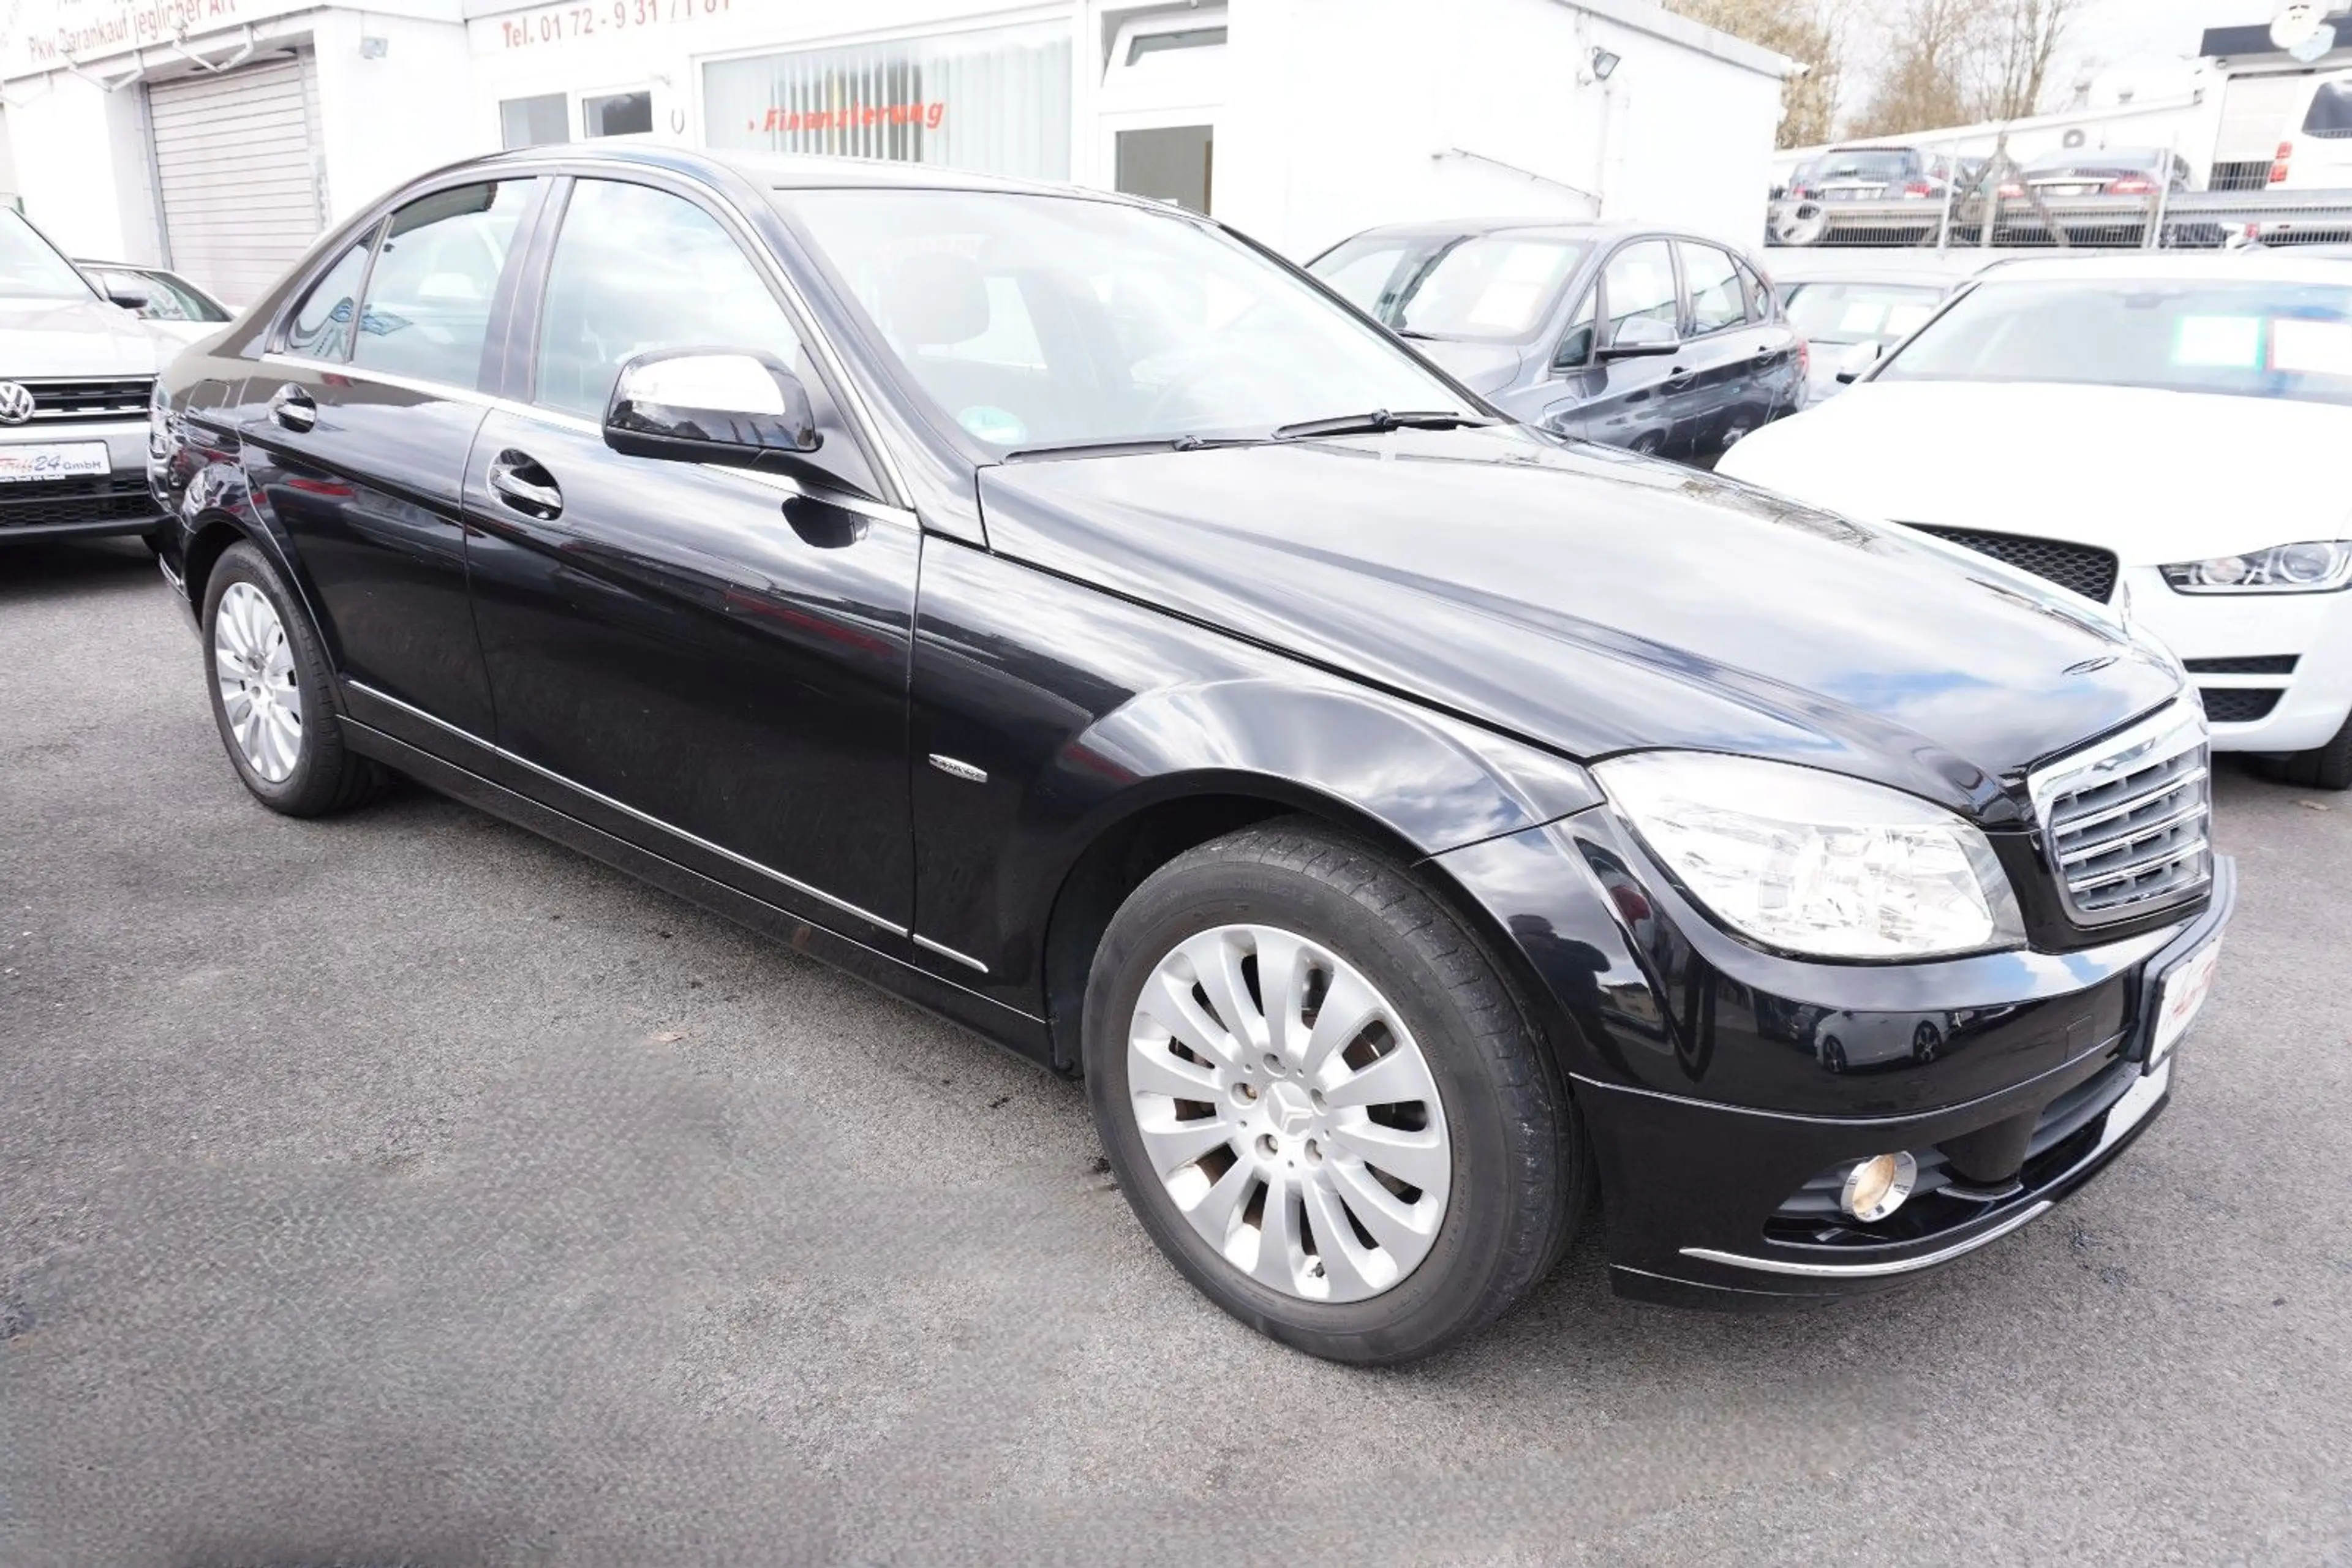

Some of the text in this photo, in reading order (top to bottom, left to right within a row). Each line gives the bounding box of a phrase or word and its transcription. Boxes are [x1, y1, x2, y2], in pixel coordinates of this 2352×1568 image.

[502, 17, 535, 48] Tel.
[541, 13, 562, 42] 01
[569, 7, 594, 36] 72
[614, 1, 625, 29] 9
[635, 0, 657, 26] 31
[27, 34, 56, 63] Pkw
[764, 100, 944, 132] Finanzierung
